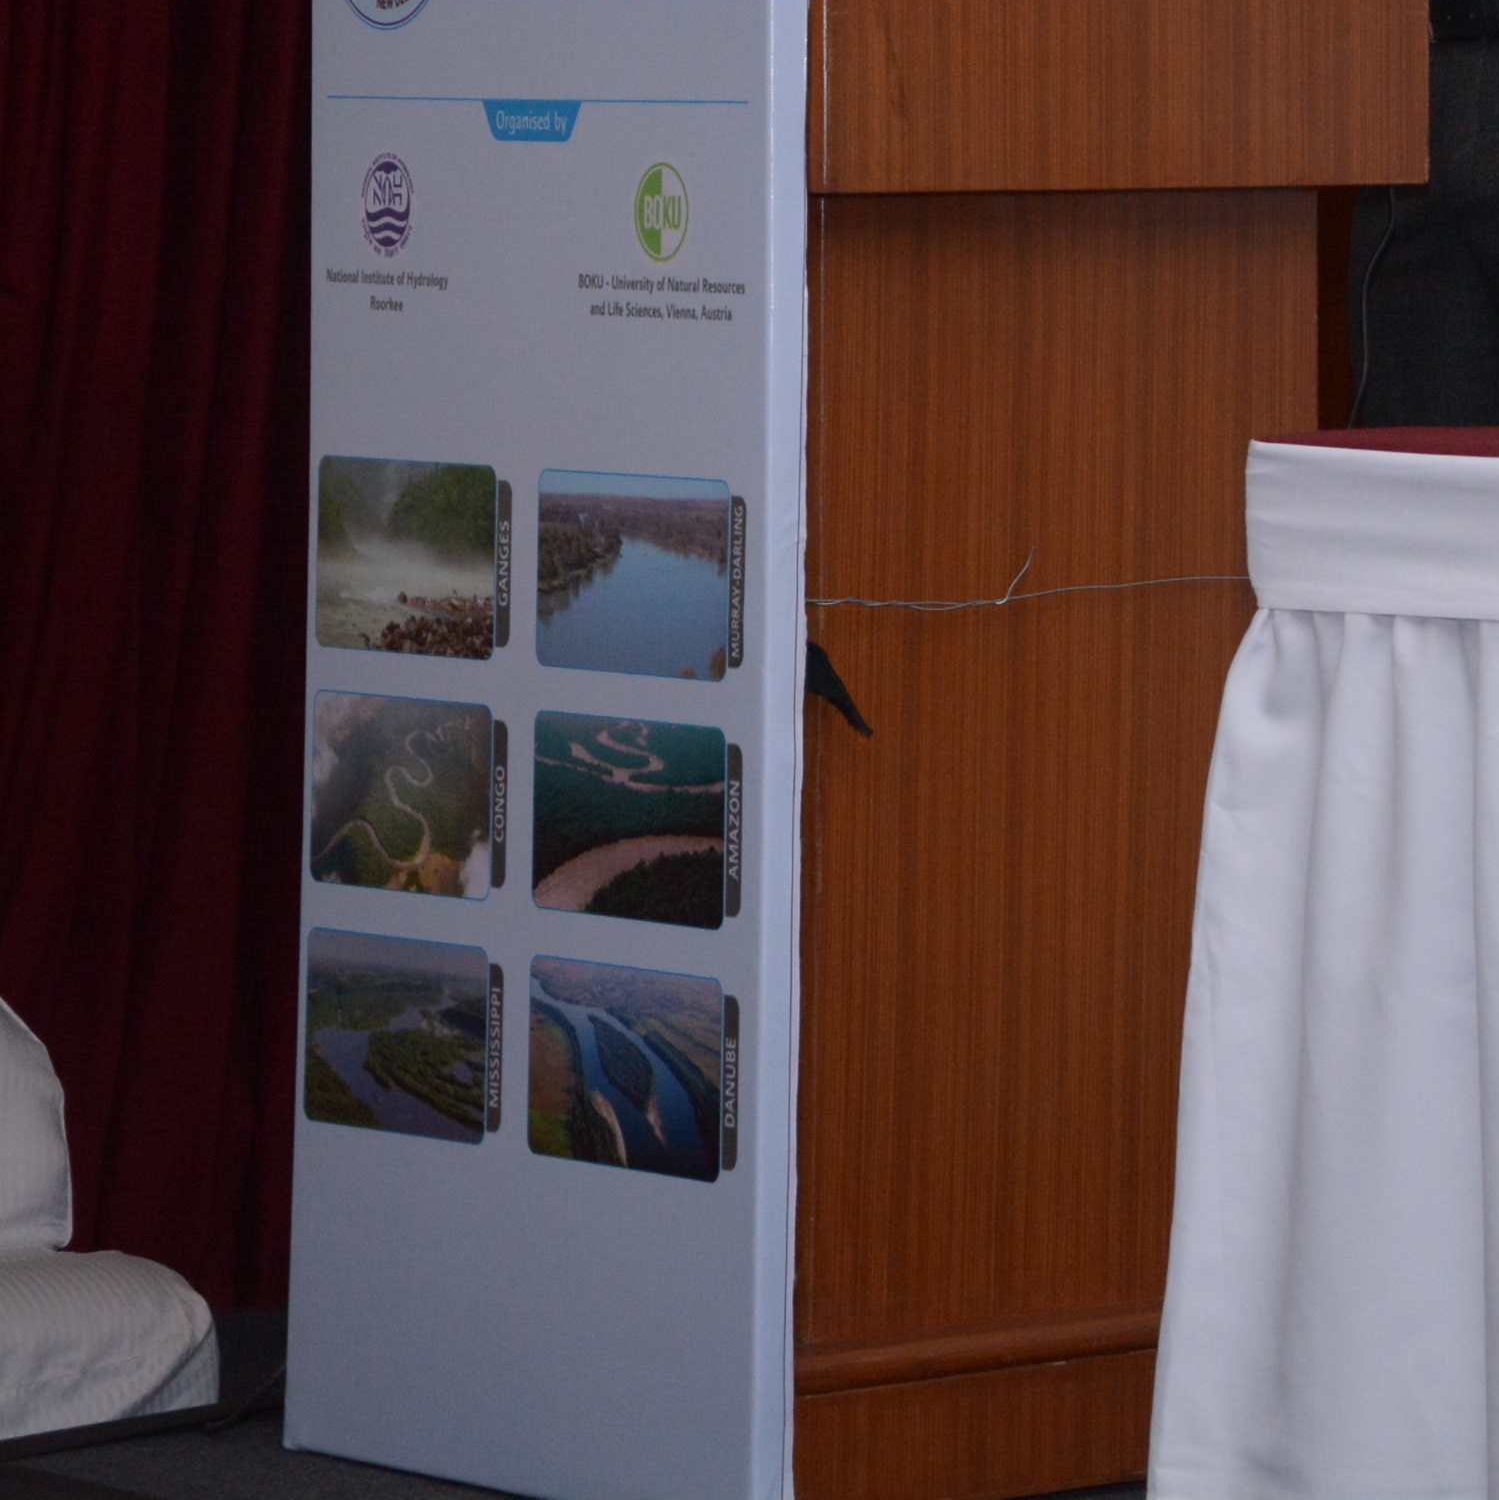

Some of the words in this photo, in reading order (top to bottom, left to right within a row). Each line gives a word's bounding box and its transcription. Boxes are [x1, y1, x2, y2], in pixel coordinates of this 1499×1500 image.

[496, 110, 550, 135] Organised
[554, 111, 568, 135] by
[644, 195, 682, 230] BOKU
[326, 268, 359, 283] National
[361, 269, 395, 285] Institute
[396, 271, 405, 285] of
[407, 271, 449, 291] Hydrology
[370, 295, 403, 312] Roorkee
[578, 273, 604, 289] BOKU
[611, 275, 654, 295] University
[657, 276, 665, 291] of
[668, 277, 700, 293] Natural
[702, 278, 746, 295] Resources
[590, 302, 606, 316] and
[608, 302, 623, 317] Life
[626, 302, 663, 320] Sciences,
[665, 304, 698, 321] Vienna,
[701, 304, 732, 321] Austria
[499, 520, 510, 607] GANGES
[731, 504, 744, 659] MURRAY-DARLING
[494, 766, 506, 843] CONGO
[728, 779, 740, 880] AMAZON
[489, 986, 502, 1109] MISSISSIPPI
[724, 1036, 737, 1129] DANUBE
